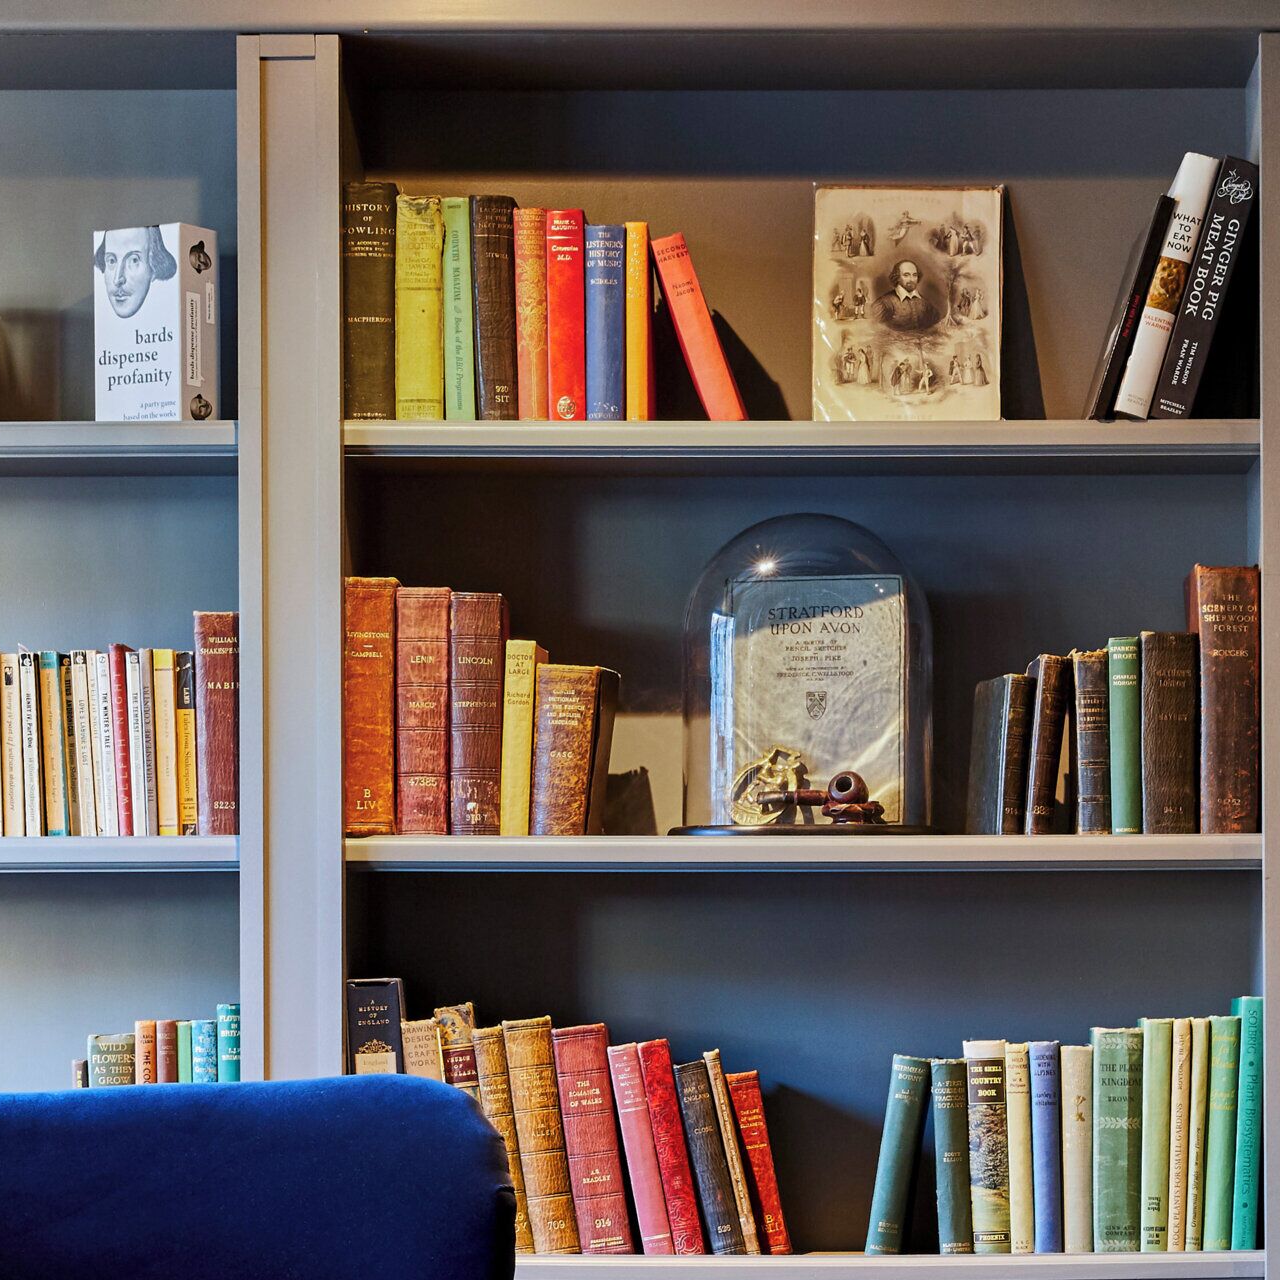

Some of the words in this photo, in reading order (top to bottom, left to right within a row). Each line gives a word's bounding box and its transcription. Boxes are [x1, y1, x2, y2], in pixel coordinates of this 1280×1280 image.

[1173, 213, 1202, 226] WHAT
[1179, 223, 1191, 233] TO
[1173, 233, 1192, 243] EAT
[1200, 213, 1224, 265] MEAT
[656, 244, 687, 256] SECOND
[1167, 241, 1192, 253] NOW
[658, 251, 689, 264] HARVEST
[1211, 219, 1240, 286] GINGER
[1185, 268, 1208, 317] BOOK
[1202, 292, 1219, 321] PIG
[136, 327, 173, 344] bards
[99, 350, 158, 367] dispense
[1182, 358, 1194, 385] WILSON
[108, 370, 172, 391] profanity
[495, 395, 510, 403] SIT
[768, 606, 864, 620] STRATFORD
[770, 621, 812, 635] UPON
[819, 622, 861, 634] AVON
[1213, 624, 1248, 632] FOREST
[410, 655, 435, 664] LENIN
[458, 657, 493, 665] LINCOLN
[364, 789, 371, 798] B
[356, 801, 376, 810] LIV
[1248, 1009, 1258, 1057] SOLBRIG
[405, 1034, 437, 1043] DESIGN
[99, 1043, 127, 1051] WILD
[92, 1054, 135, 1063] FLOWERS
[410, 1059, 436, 1067] WORK
[94, 1066, 106, 1074] AS
[110, 1066, 134, 1074] THEY
[98, 1075, 130, 1084] GROW
[576, 1080, 590, 1088] THE
[970, 1077, 1003, 1085] COUNTRY
[569, 1088, 600, 1098] ROMANCE
[978, 1088, 997, 1097] BOOK
[1247, 1073, 1258, 1105] Plant
[570, 1099, 580, 1107] OF
[582, 1097, 603, 1106] WALES
[683, 1092, 710, 1103] ENGLAND
[1242, 1107, 1258, 1195] Biosystematics
[547, 1221, 566, 1230] 709
[978, 1233, 1006, 1241] PHOENIX
